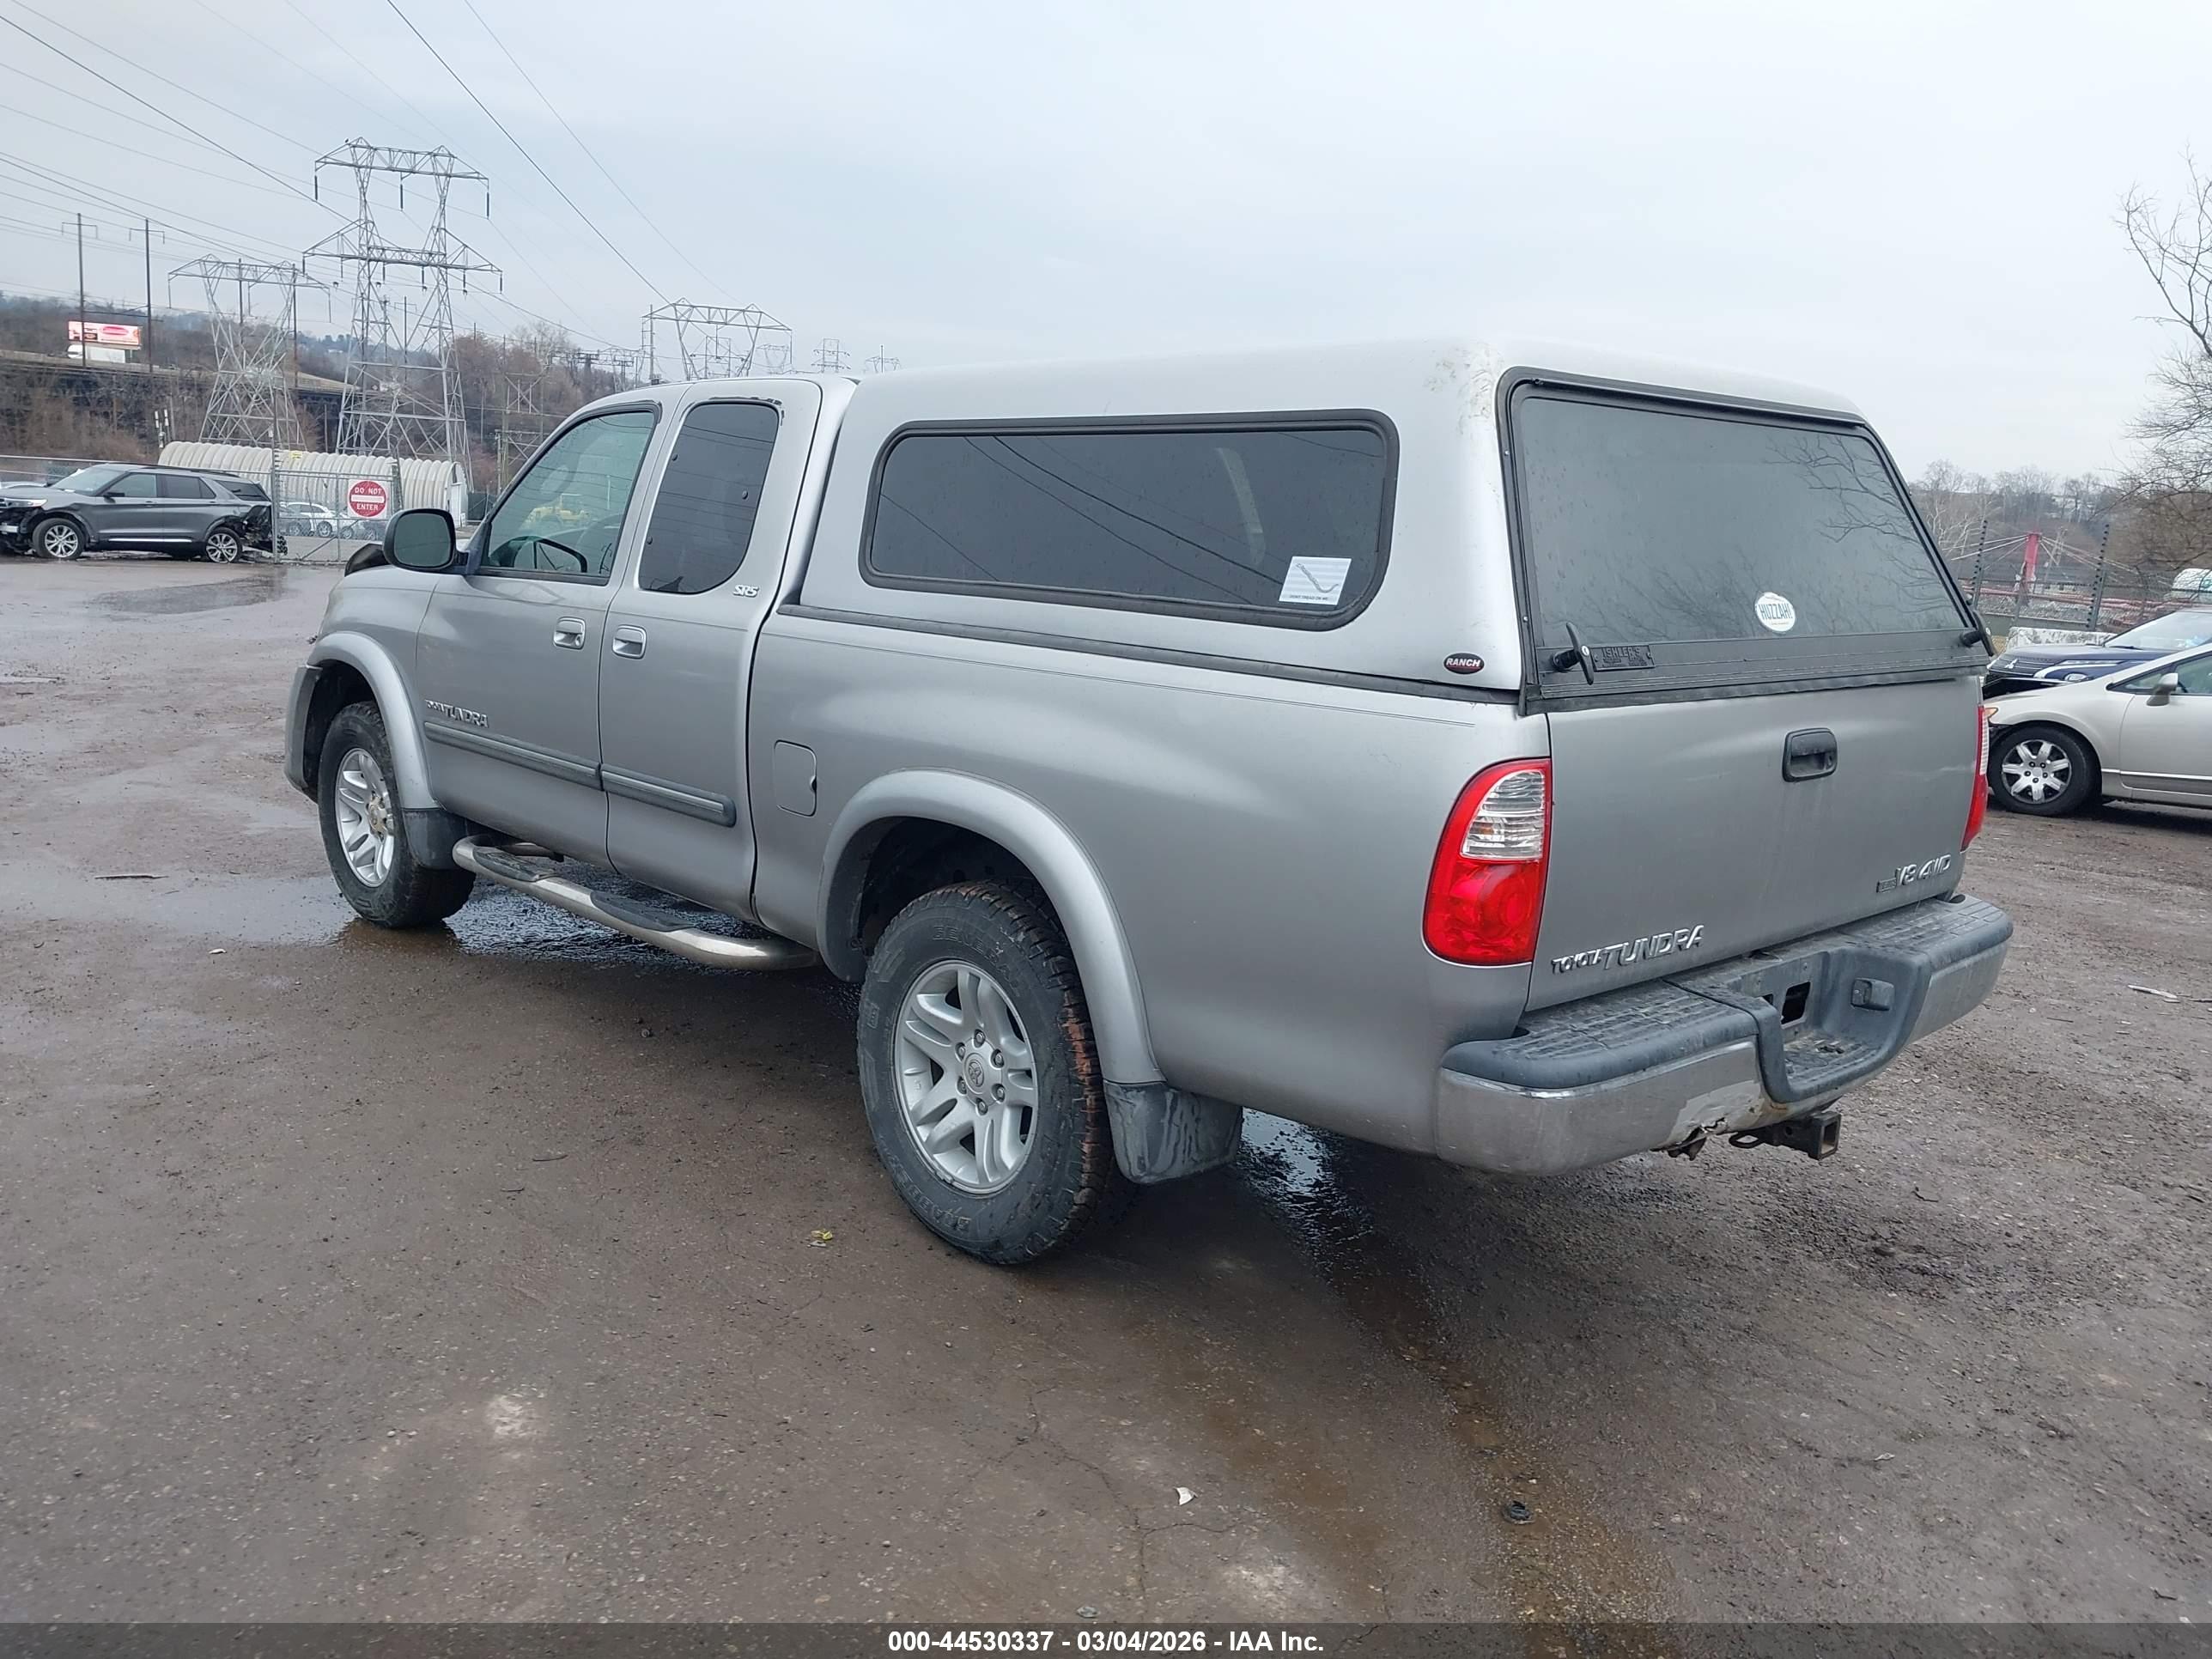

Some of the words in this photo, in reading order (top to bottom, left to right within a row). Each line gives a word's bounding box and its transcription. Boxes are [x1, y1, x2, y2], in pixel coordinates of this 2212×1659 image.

[1758, 603, 1793, 620] HUZZAH!
[1446, 658, 1480, 667] RANCH
[1602, 924, 1705, 969] TUNDRA
